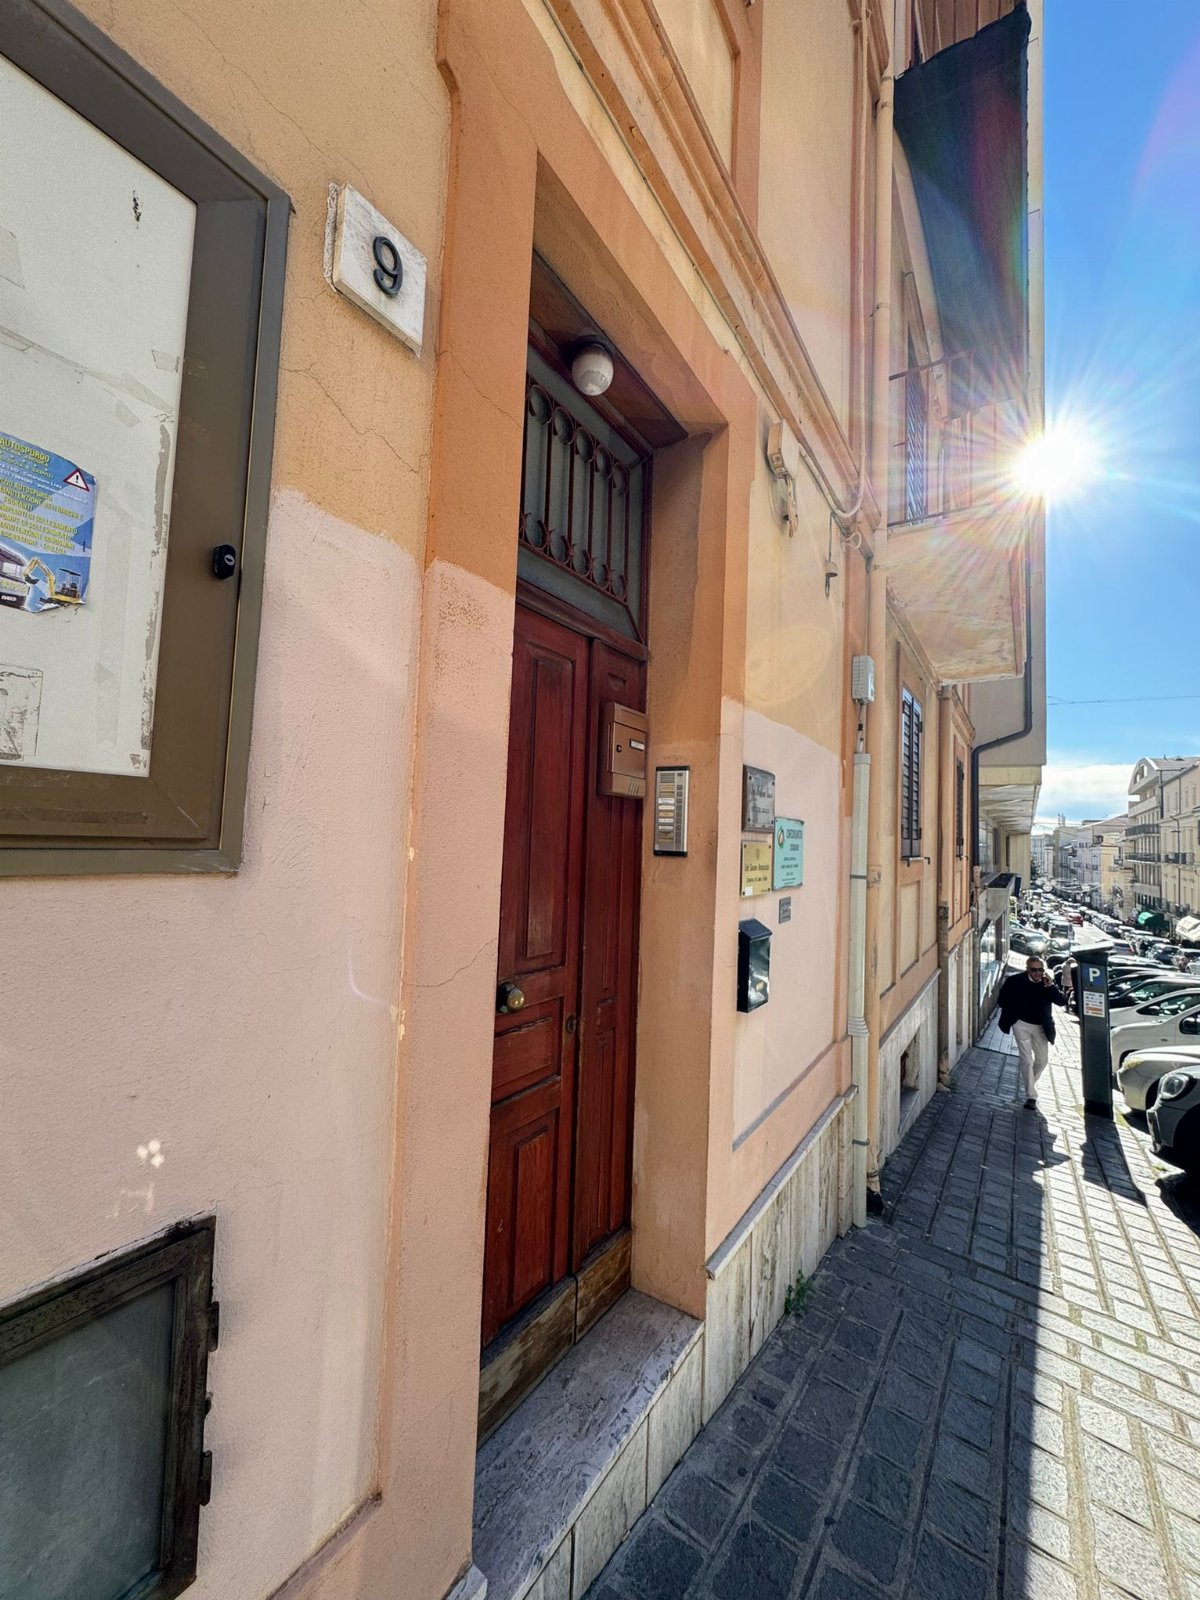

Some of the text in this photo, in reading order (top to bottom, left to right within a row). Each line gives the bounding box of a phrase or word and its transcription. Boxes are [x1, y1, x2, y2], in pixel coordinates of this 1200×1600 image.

[372, 236, 403, 298] 9
[0, 437, 50, 462] AUTOSPURGO
[1089, 968, 1100, 982] P
